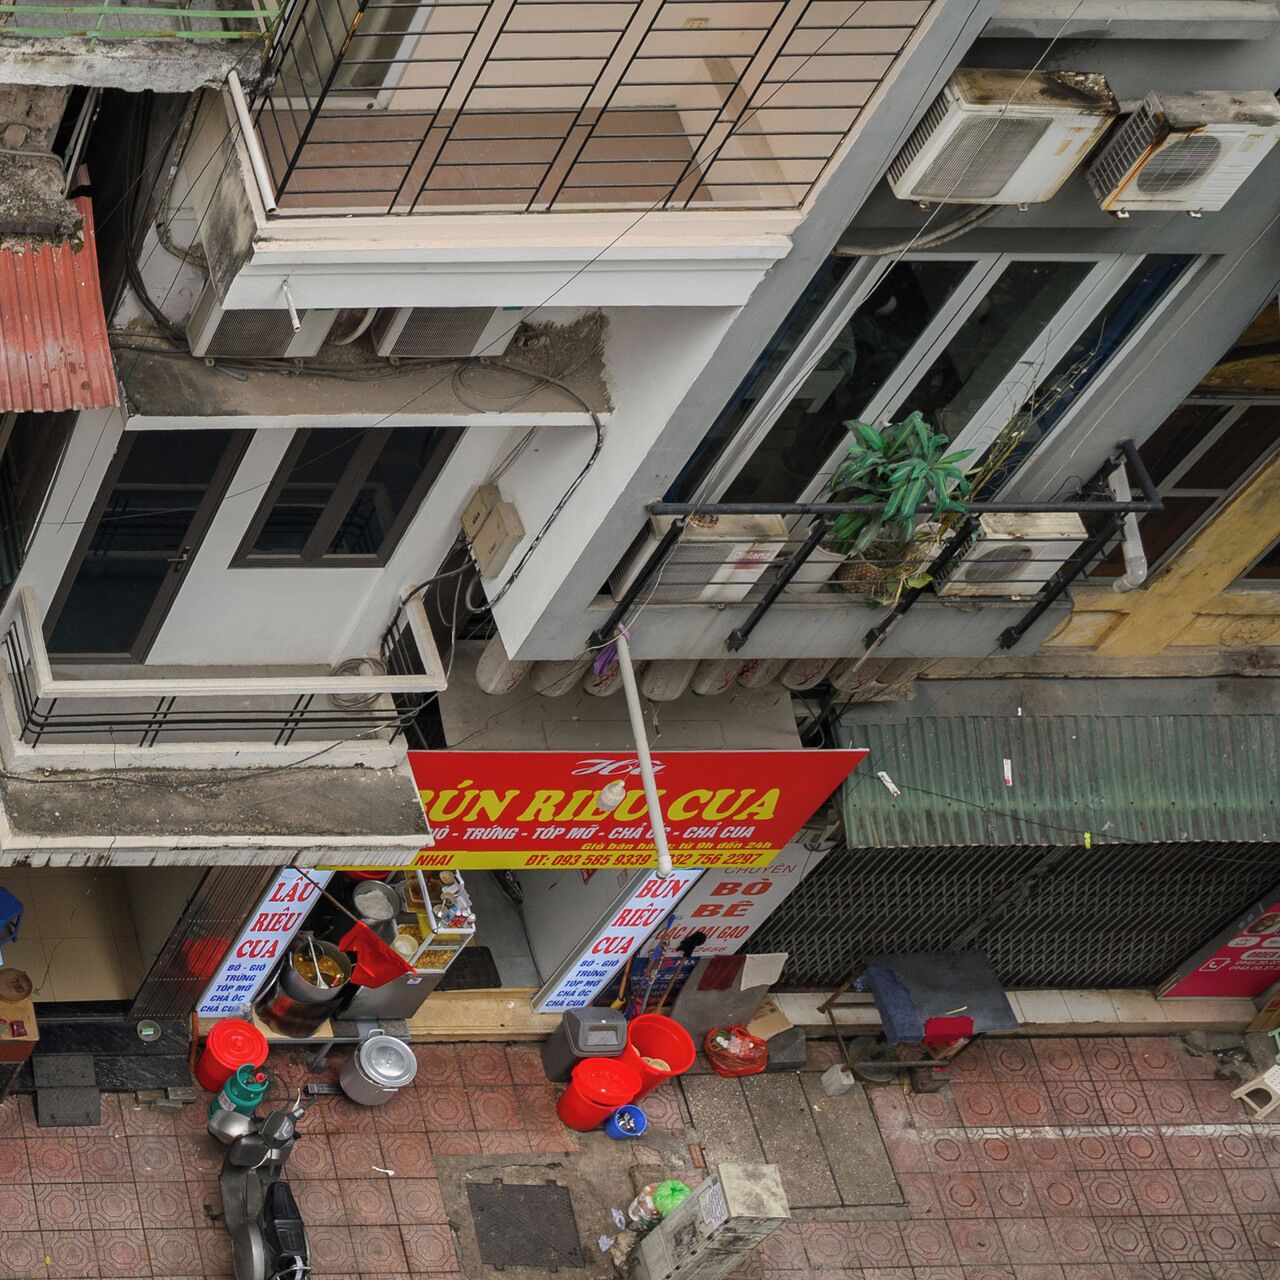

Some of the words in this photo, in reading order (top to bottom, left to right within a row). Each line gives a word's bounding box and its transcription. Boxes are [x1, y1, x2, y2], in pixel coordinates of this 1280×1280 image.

[667, 788, 780, 821] CUA
[463, 824, 519, 840] TRỨNG
[532, 825, 566, 840] TÓP
[566, 824, 599, 840] MỠ
[608, 822, 647, 839] CHẢ
[683, 822, 721, 839] CHẢ
[720, 826, 756, 839] CUA
[525, 855, 550, 866] ĐT:
[551, 855, 581, 866] 093
[581, 855, 612, 866] 585
[612, 853, 652, 866] 9339
[696, 853, 721, 866] 756
[722, 853, 764, 865] 2297
[269, 871, 320, 902] LẨU
[635, 874, 689, 898] BÚN
[709, 878, 773, 896] BÒ
[611, 903, 666, 927] RIÊU
[691, 900, 754, 917] BÊ
[249, 906, 302, 932] RIÊU
[236, 940, 279, 958] CUA
[591, 936, 635, 954] CUA
